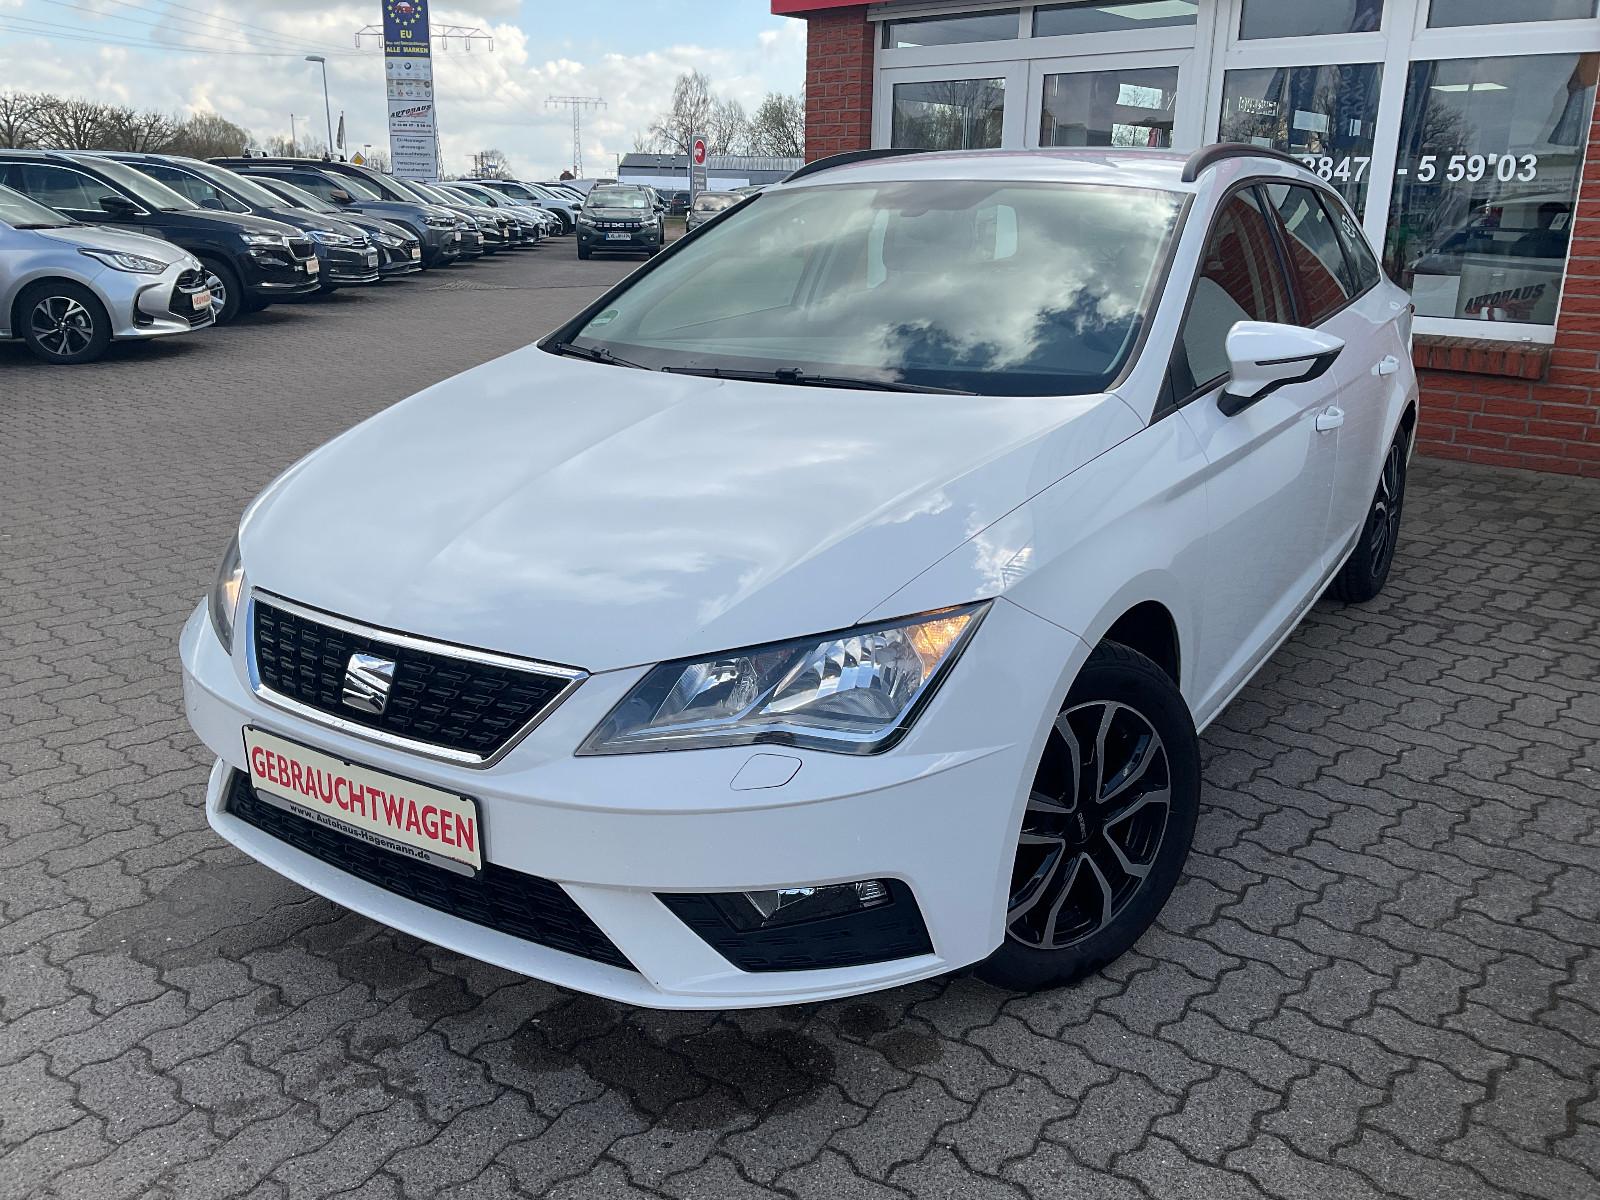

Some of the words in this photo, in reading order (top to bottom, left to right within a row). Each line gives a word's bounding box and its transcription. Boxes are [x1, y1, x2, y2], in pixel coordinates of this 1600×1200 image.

[400, 30, 412, 38] EU
[390, 104, 432, 118] AUTOHAUS
[1417, 155, 1437, 182] 5
[1446, 154, 1486, 182] 59
[1496, 154, 1538, 182] 03
[1464, 283, 1546, 312] AUTOHAUS
[251, 746, 475, 852] GEBRAUCHTWAGEN
